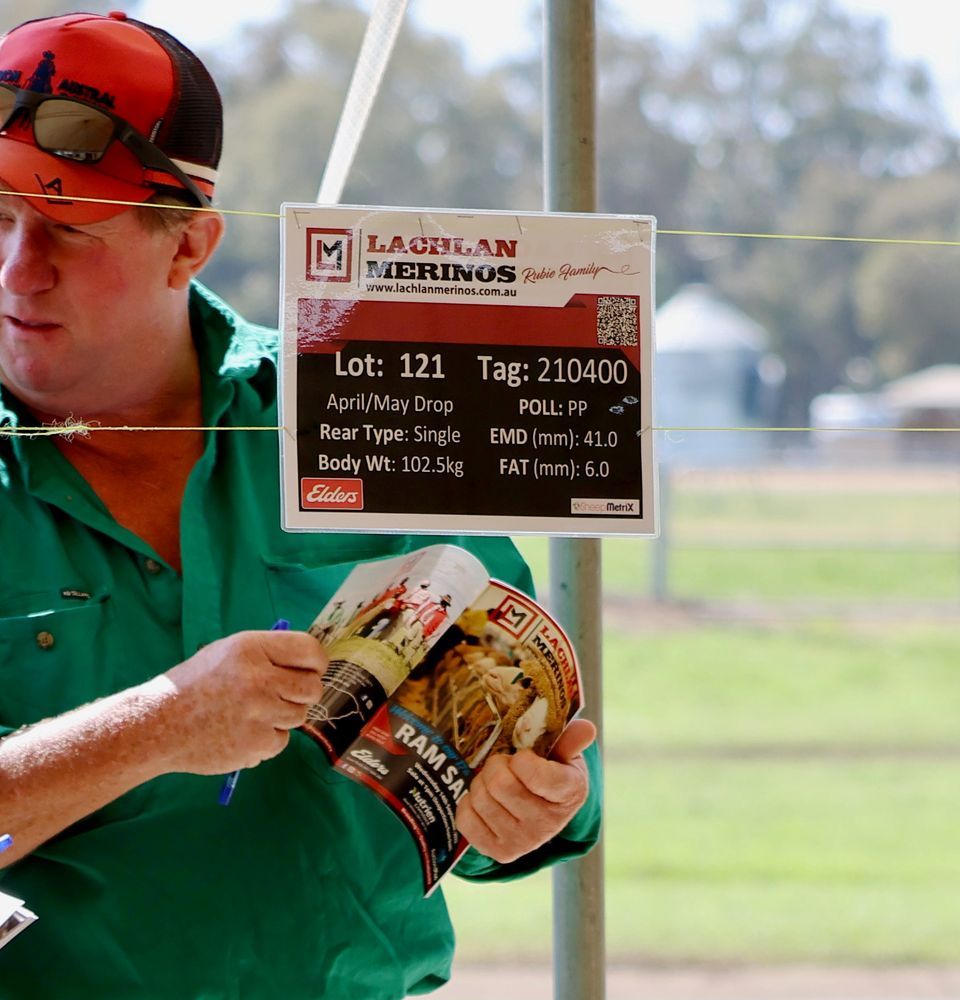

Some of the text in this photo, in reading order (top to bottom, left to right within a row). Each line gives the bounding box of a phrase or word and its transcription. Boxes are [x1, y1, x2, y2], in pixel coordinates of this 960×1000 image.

[367, 235, 518, 258] LACHLAN
[366, 260, 517, 284] MERINOS
[558, 262, 606, 281] Family
[366, 282, 518, 297] www.lachlanmerinos.com.au
[335, 351, 446, 379] Lot: 121
[477, 355, 629, 388] Tag: 210400
[326, 392, 454, 417] April/May Drop
[519, 398, 588, 417] POLL: PP
[320, 423, 461, 447] Rear Type: Single
[490, 427, 618, 450] EMD (mm): 41.0
[318, 453, 464, 478] Body Wt: 102.5kg
[499, 457, 610, 480] FAT (mm): 6.0
[306, 484, 359, 504] Elders
[531, 635, 567, 709] MERINOS
[394, 723, 448, 772] RAM
[350, 749, 390, 776] Elders
[409, 787, 437, 824] Nutrien
